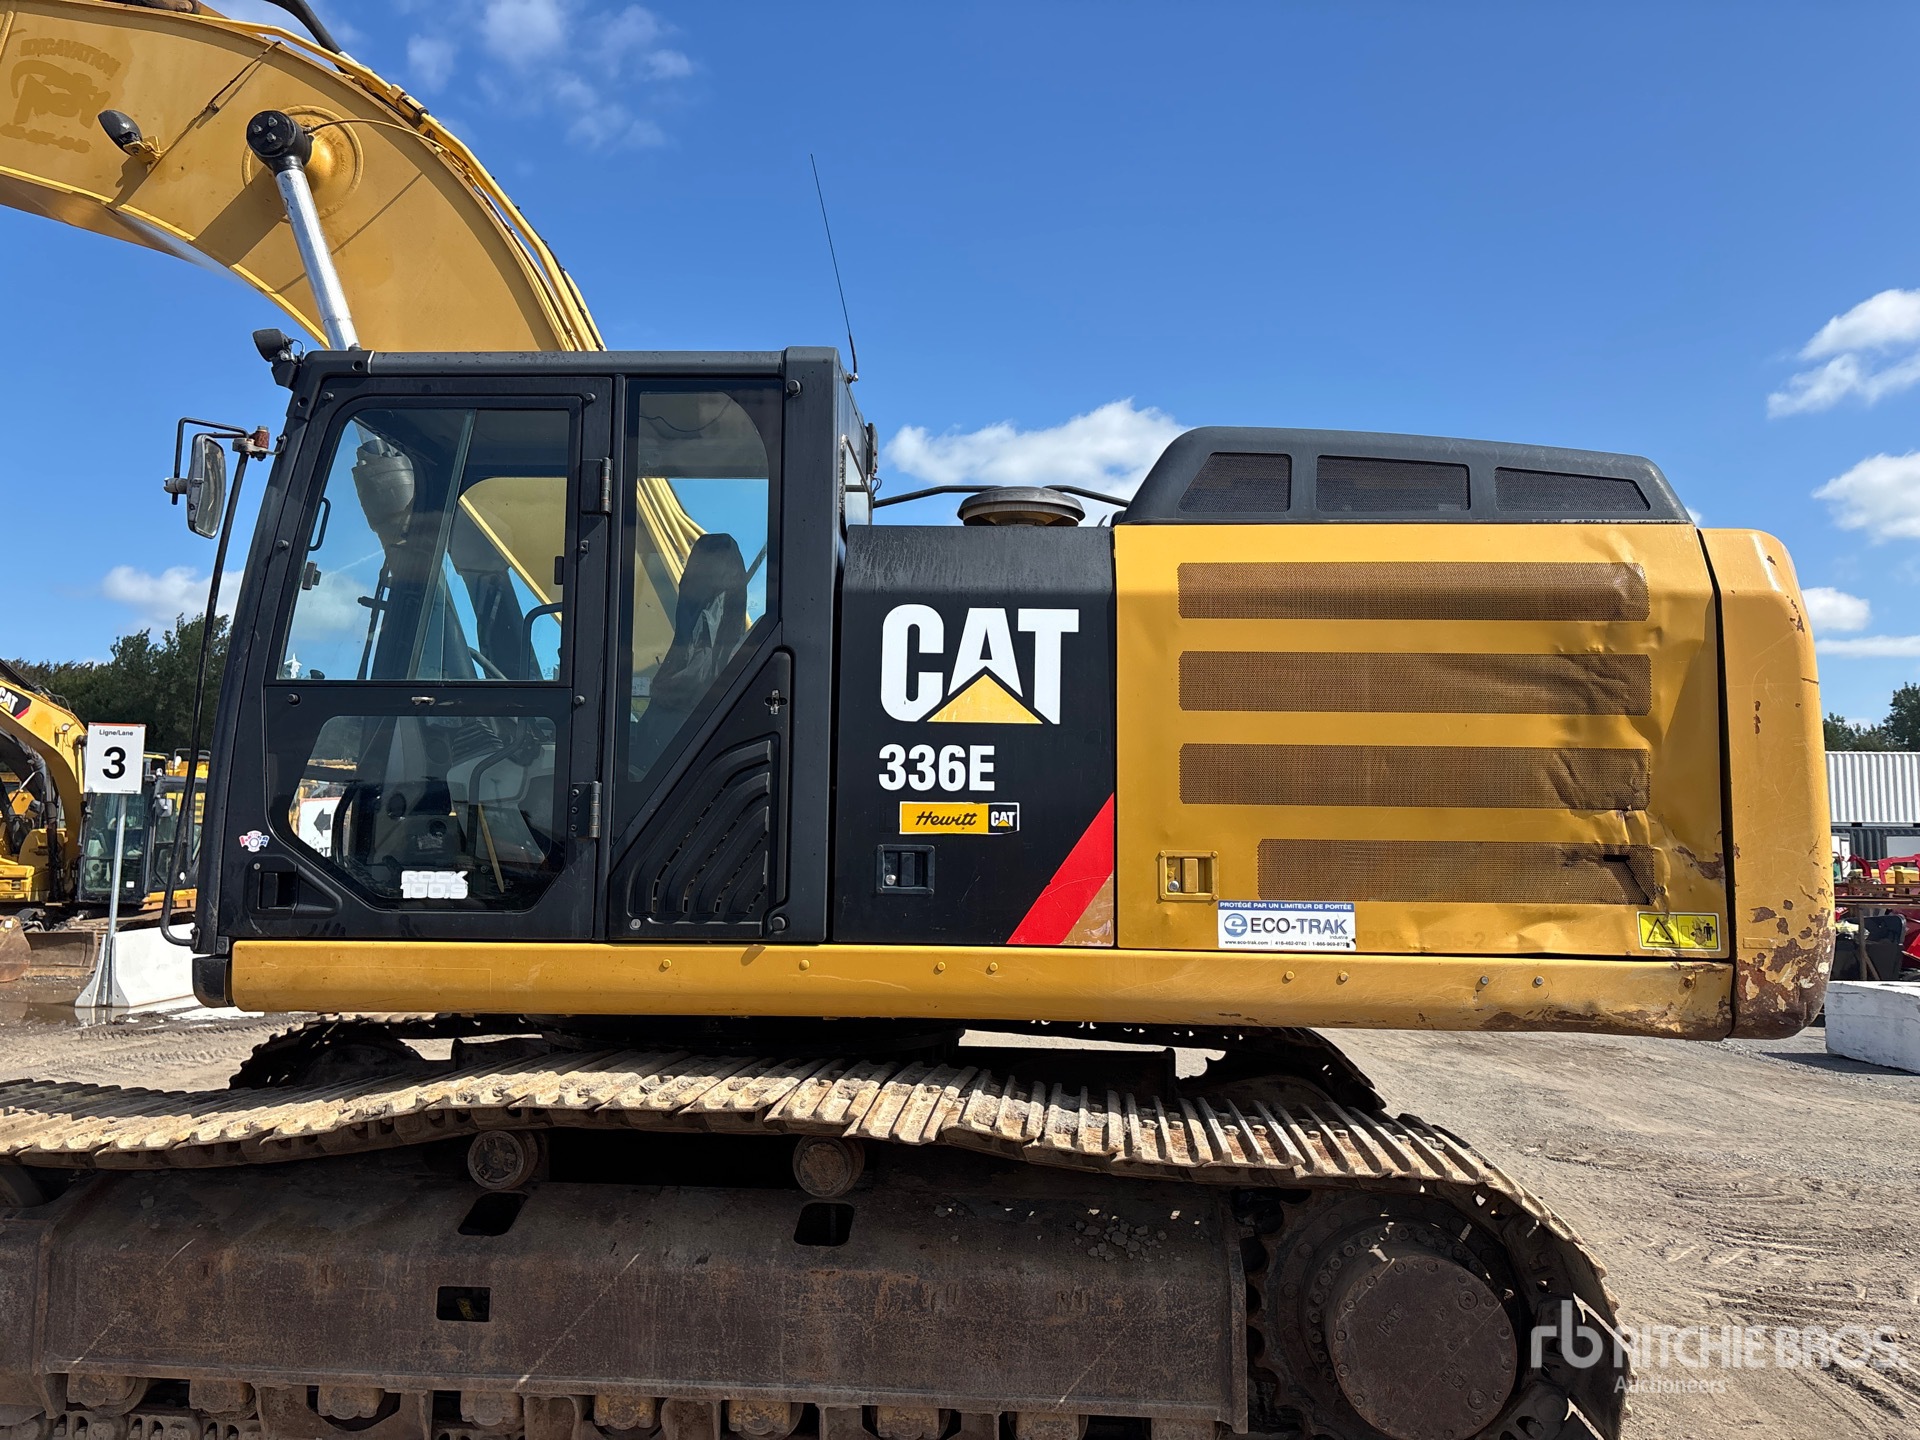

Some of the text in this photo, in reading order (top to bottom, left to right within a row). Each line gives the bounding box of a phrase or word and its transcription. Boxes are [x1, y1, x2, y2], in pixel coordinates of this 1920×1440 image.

[880, 604, 1079, 725] CAT
[0, 687, 19, 714] CAT
[99, 729, 134, 737] Ligne/Lane
[102, 746, 127, 779] 3
[878, 743, 995, 792] 336E
[915, 811, 978, 827] Hewitt
[990, 811, 1016, 827] CAT
[1219, 901, 1252, 909] PROTÉGÉ
[1325, 902, 1352, 911] PORTÉE
[1250, 917, 1348, 935] ECO-TRAK
